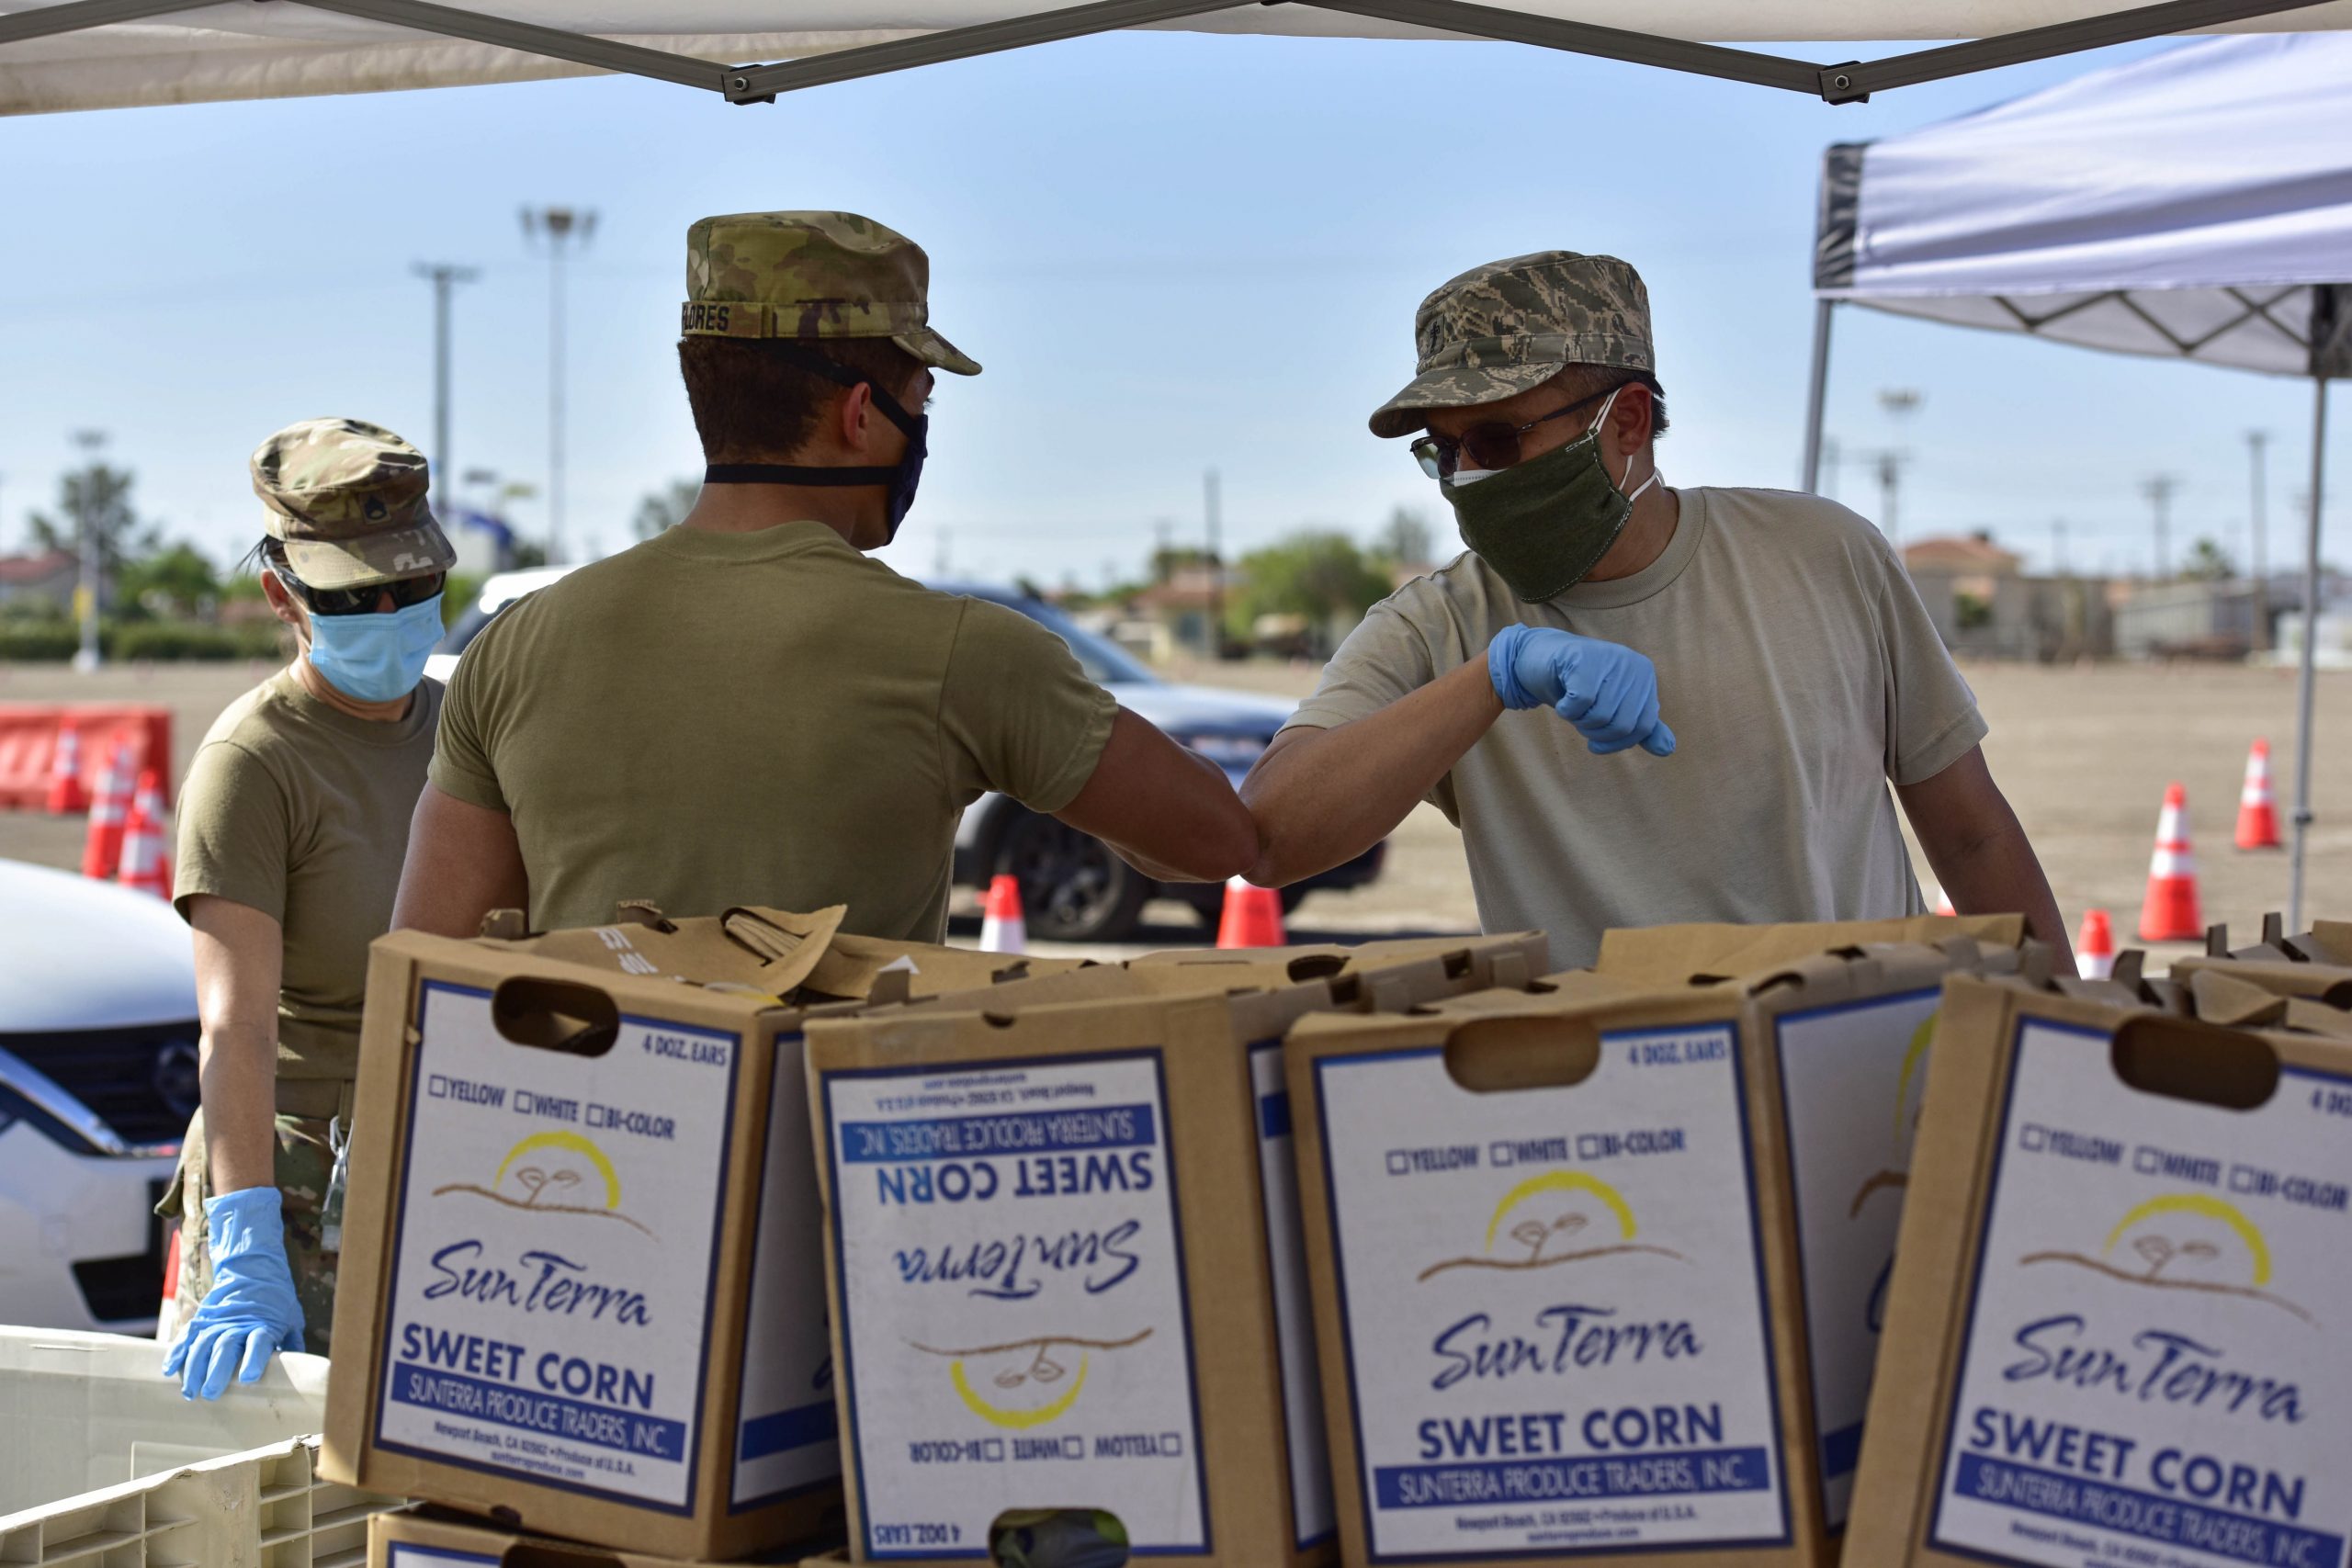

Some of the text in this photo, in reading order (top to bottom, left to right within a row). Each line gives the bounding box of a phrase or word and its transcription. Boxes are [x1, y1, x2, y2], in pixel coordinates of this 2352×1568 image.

[643, 1034, 726, 1066] 4 DOZ. EARS
[1629, 1044, 1638, 1066] 4
[448, 1079, 675, 1139] YELLOW WHITE BI-COLOR
[965, 1116, 1046, 1151] PRODUCE
[1049, 1111, 1135, 1145] SUNTERRA
[1409, 1128, 1686, 1173] YELLOW WHITE BI-COLOR
[876, 1151, 1154, 1205] SWEET CORN
[424, 1239, 651, 1326] SunTerra
[401, 1323, 654, 1410] SWEET CORN
[1430, 1304, 1704, 1391] SunTerra
[2002, 1314, 2305, 1424] SunTerra
[408, 1373, 483, 1415] SUNTERRA
[486, 1391, 558, 1430] PRODUCE
[560, 1405, 629, 1448] TRADERS,
[633, 1424, 670, 1454] INC.
[1418, 1403, 1723, 1461] SWEET CORN
[909, 1434, 1159, 1463] YELLOW WHITE BI-COLOR
[1969, 1405, 2304, 1520] SWEET CORN
[1398, 1455, 1750, 1506] SUNTERRA PRODUCE TRADERS, INC.
[1976, 1464, 2075, 1514] SUNTERRA
[2079, 1485, 2176, 1540] PRODUCE
[875, 1525, 910, 1545] EARS
[951, 1523, 960, 1542] 4
